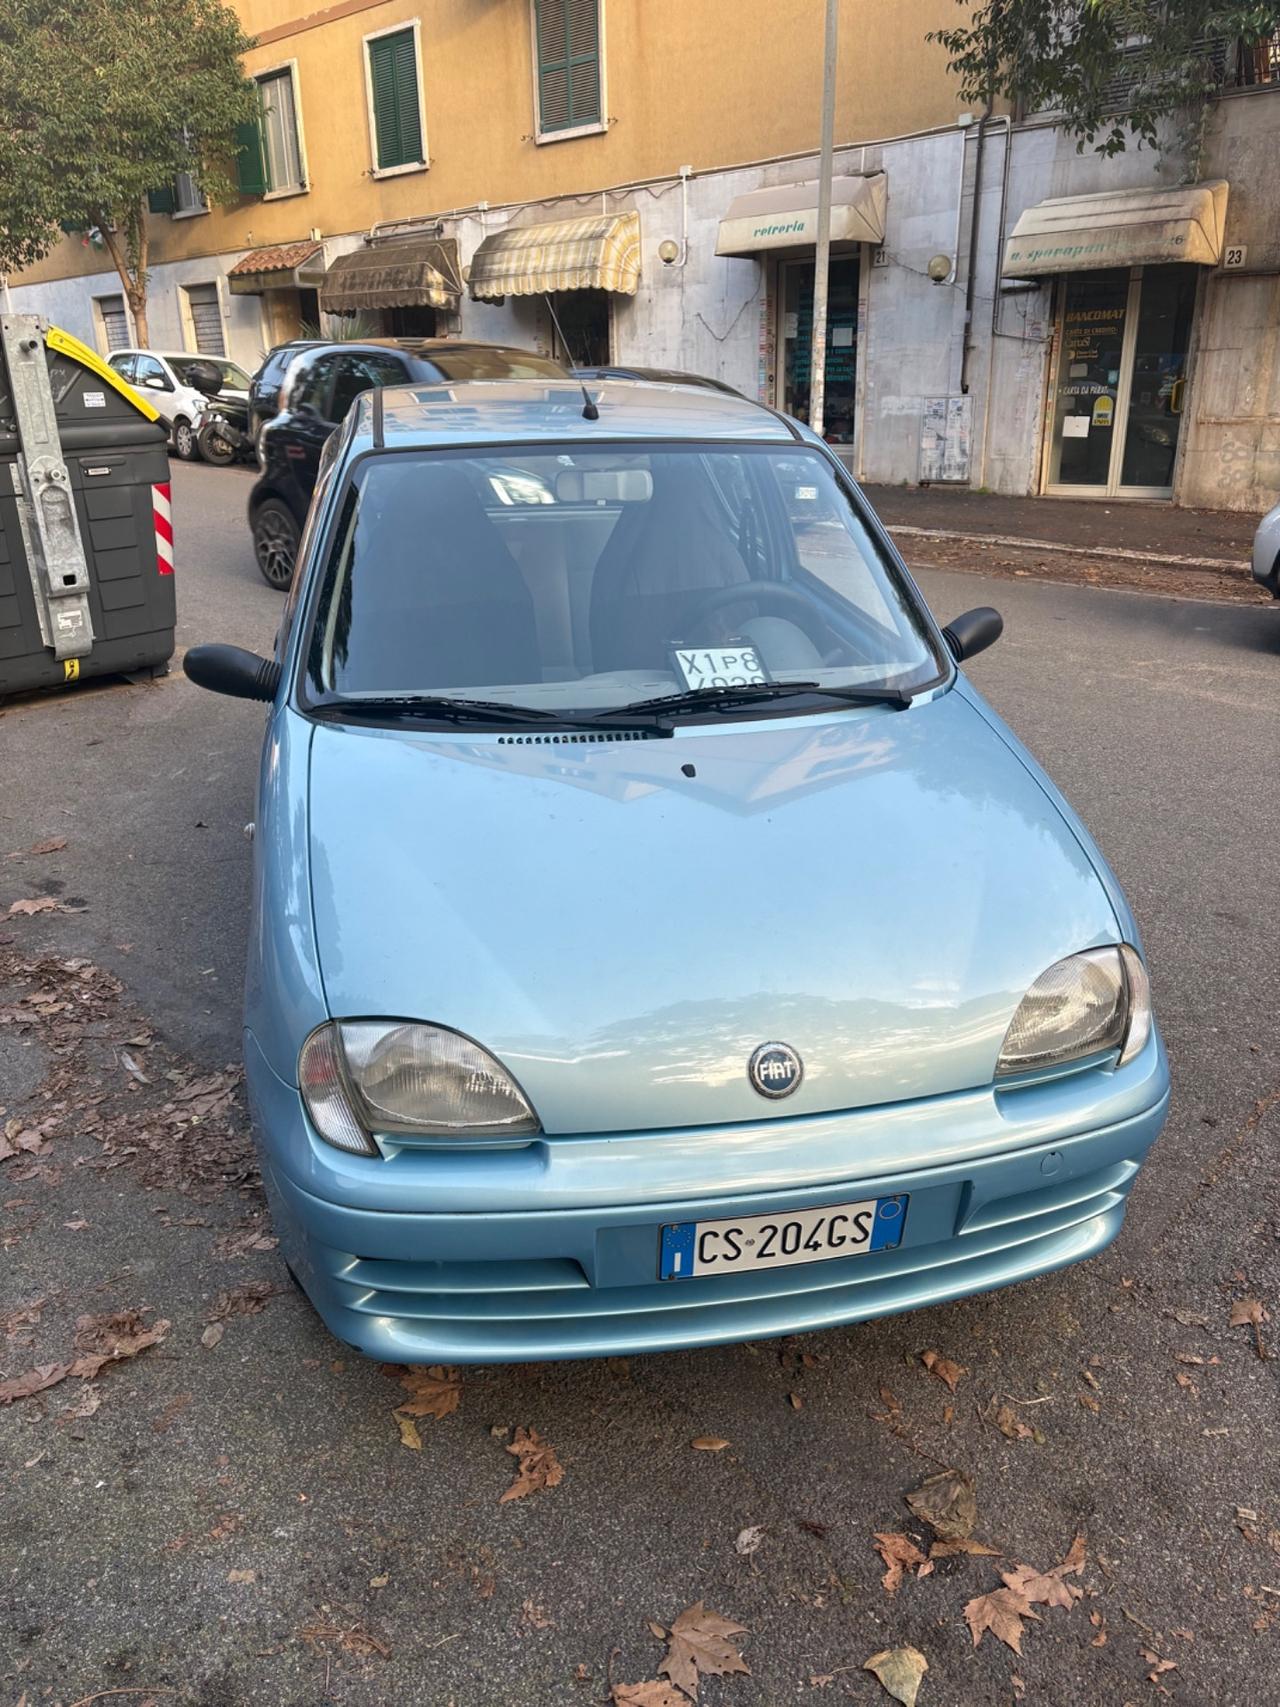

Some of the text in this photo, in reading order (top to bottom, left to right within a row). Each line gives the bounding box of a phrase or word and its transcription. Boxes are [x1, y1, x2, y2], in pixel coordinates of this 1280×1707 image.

[876, 250, 886, 264] 21
[1226, 249, 1242, 265] 23
[1065, 308, 1126, 322] BANCOMAT
[679, 651, 760, 675] X1P8
[759, 1060, 793, 1081] FIAT
